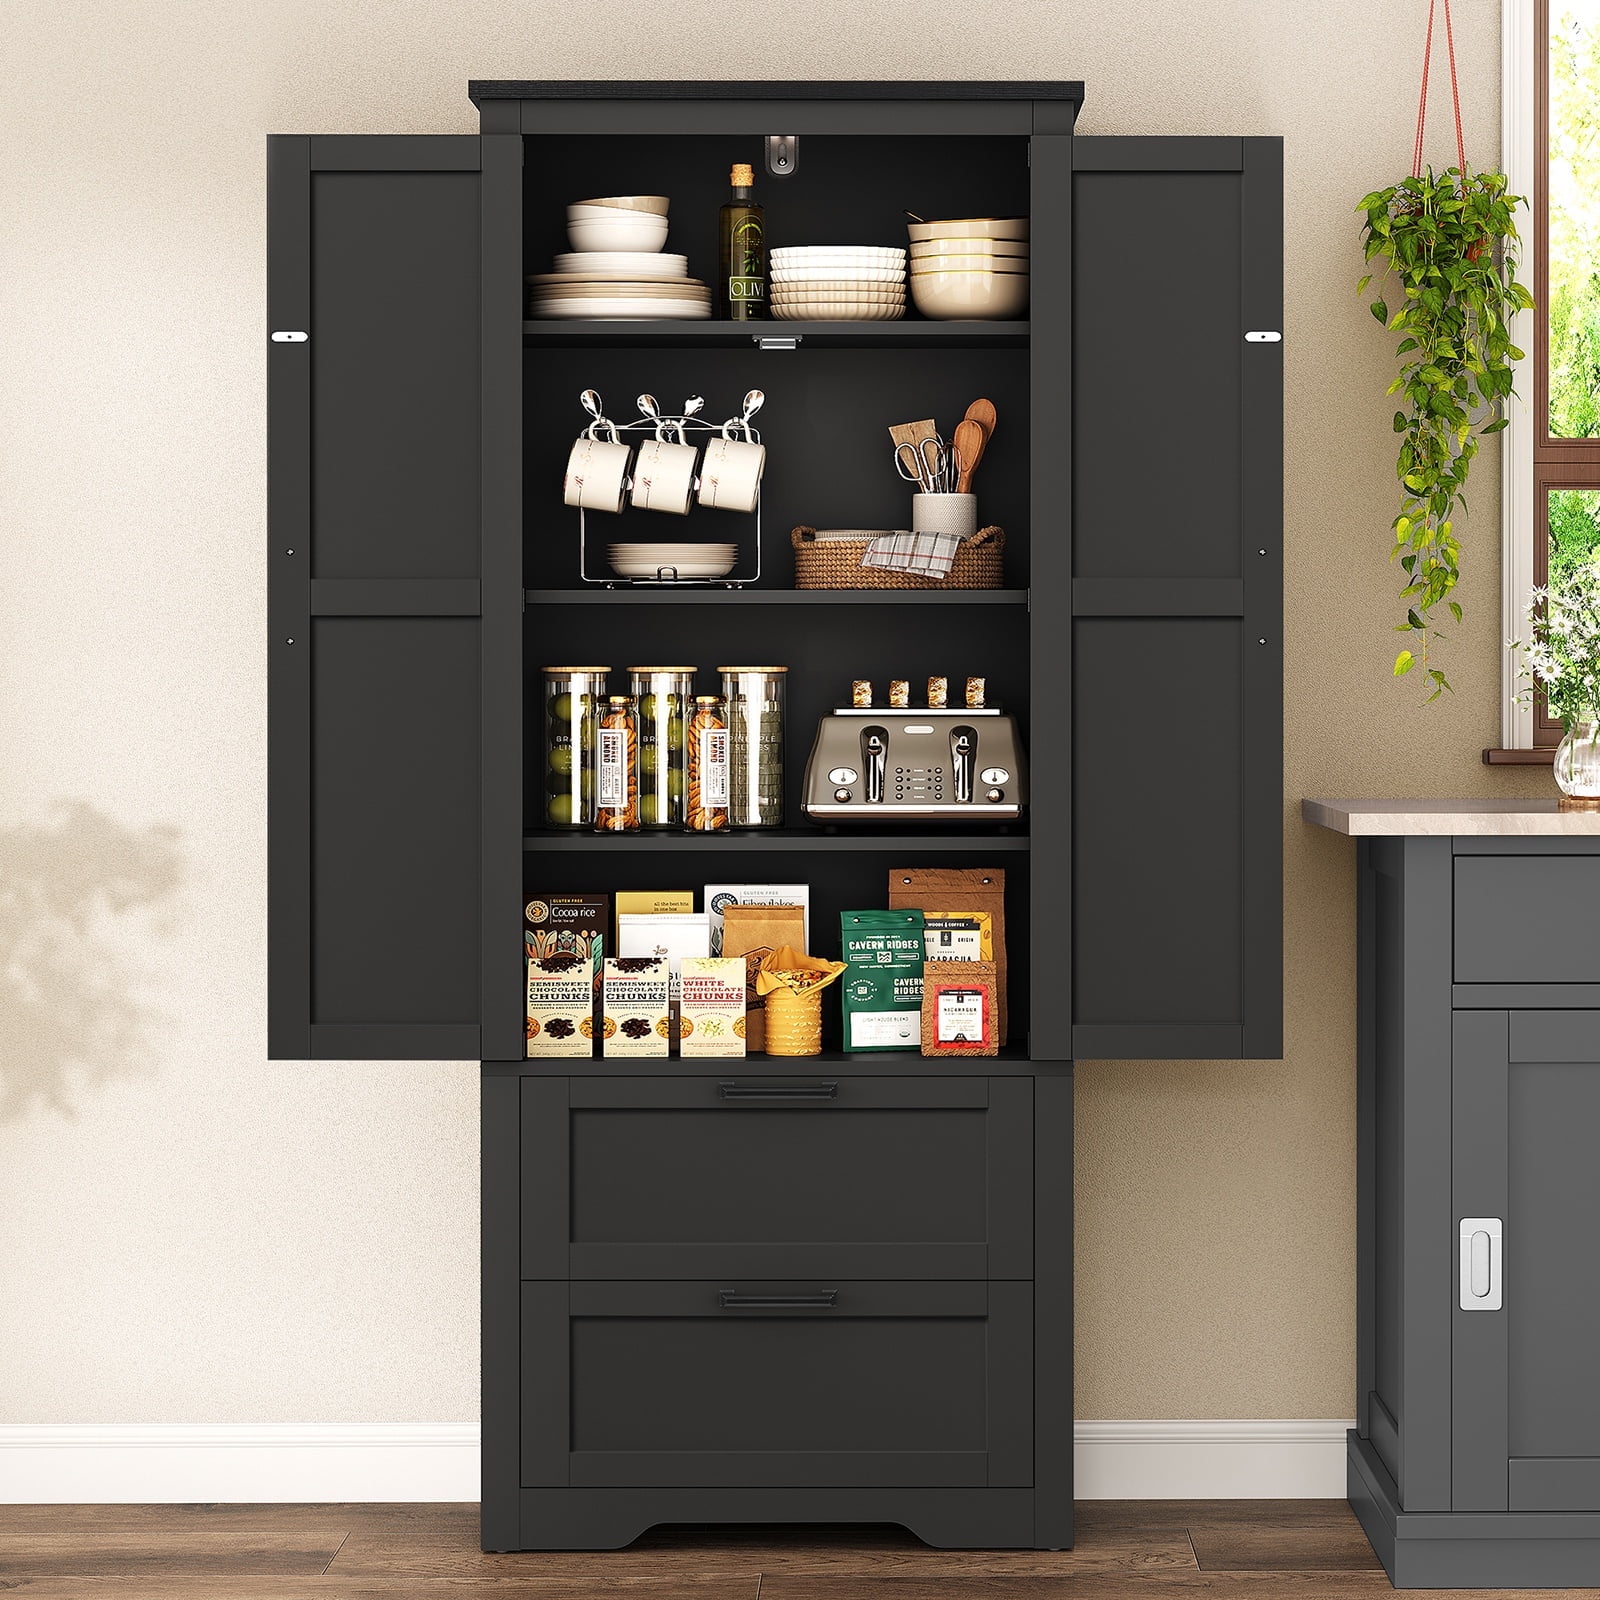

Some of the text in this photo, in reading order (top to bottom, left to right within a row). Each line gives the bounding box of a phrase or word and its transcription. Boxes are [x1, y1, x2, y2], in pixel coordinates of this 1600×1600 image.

[710, 736, 718, 763] ALMOND
[552, 907, 596, 917] Cocoa rice
[848, 940, 919, 950] CAVERN RIDGES
[894, 987, 924, 995] RIDGES
